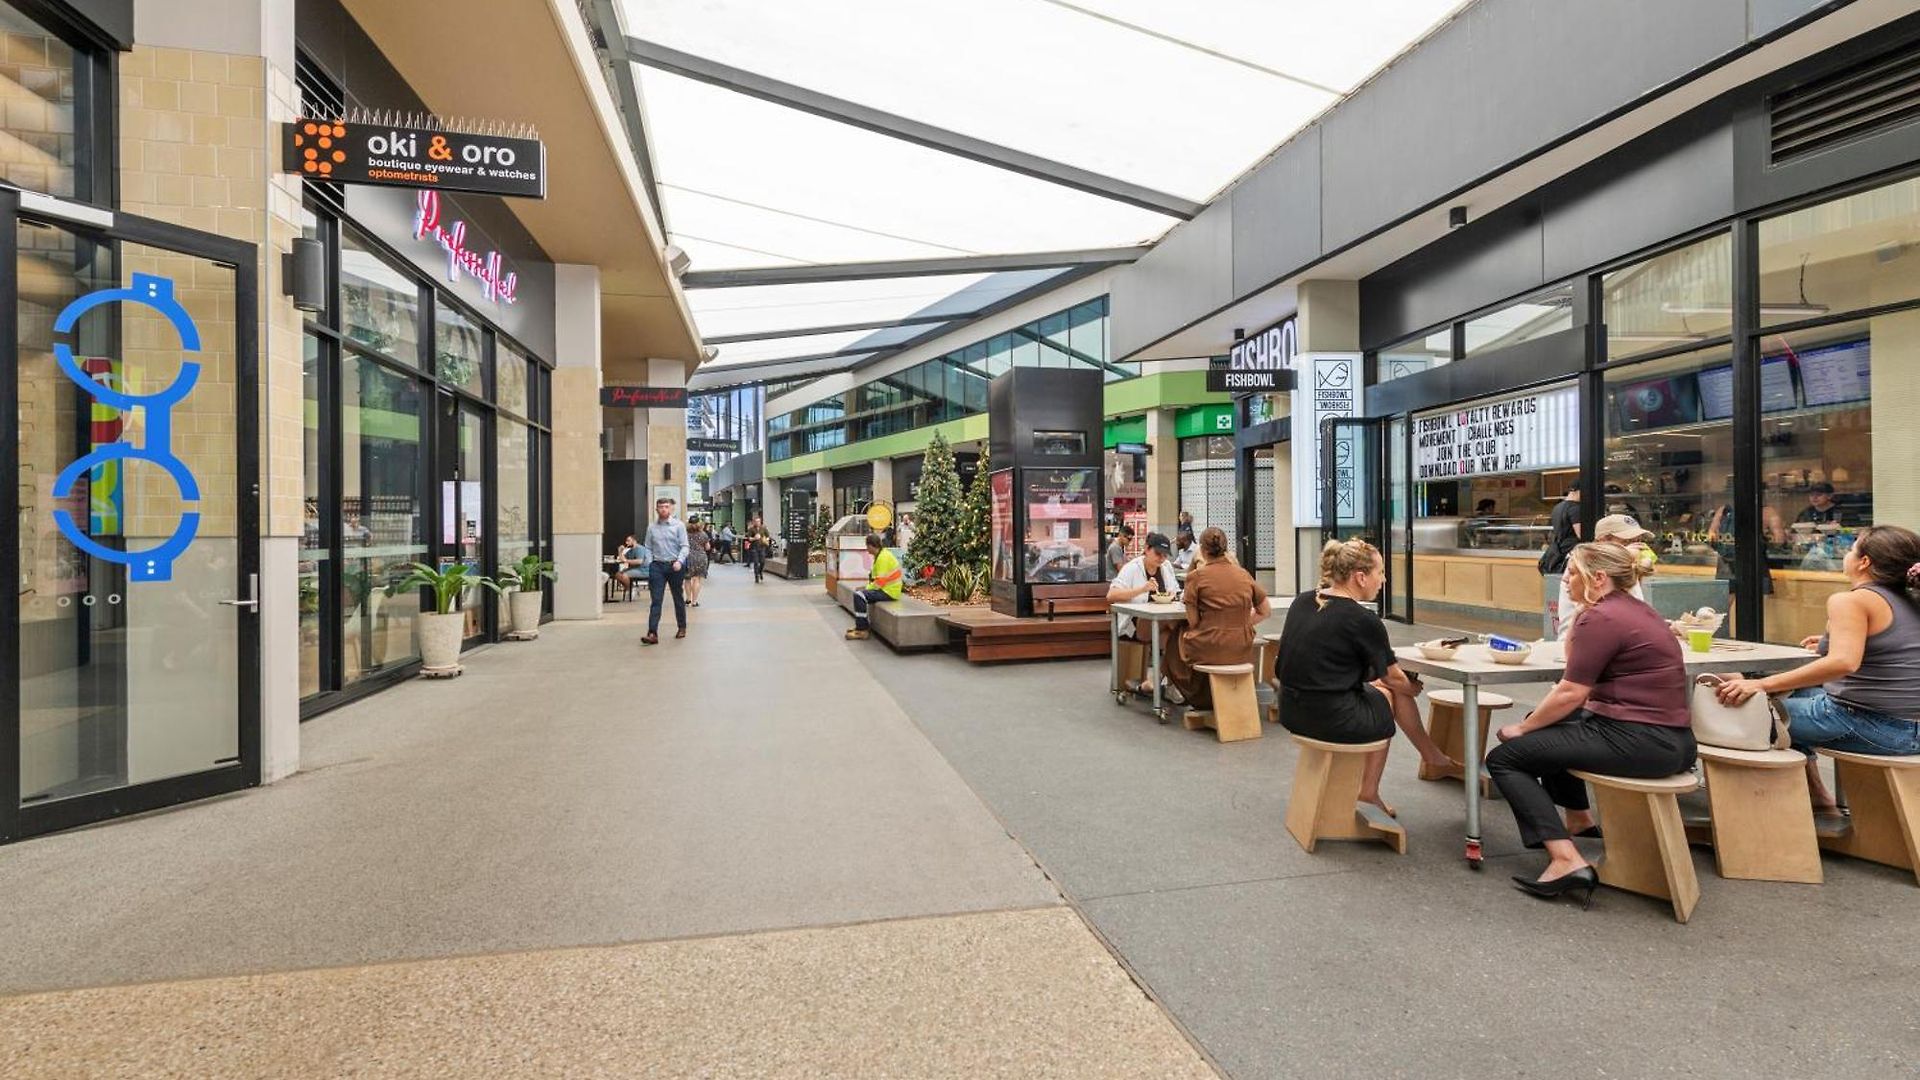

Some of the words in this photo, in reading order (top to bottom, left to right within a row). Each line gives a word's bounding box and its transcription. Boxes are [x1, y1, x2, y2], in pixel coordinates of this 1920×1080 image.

[367, 131, 416, 157] oki
[428, 135, 453, 161] &
[462, 144, 516, 166] oro
[368, 157, 421, 172] boutique
[425, 163, 474, 175] eyewear
[477, 166, 486, 176] &
[489, 169, 536, 181] watches
[368, 169, 439, 183] optometrists
[1231, 320, 1298, 370] FISHBO
[1225, 373, 1275, 387] FISHBOWL
[1317, 391, 1349, 399] FISHBOWL
[1419, 416, 1452, 433] FISHBOWL
[1457, 406, 1490, 427] LOYALTY
[1492, 398, 1537, 420] REWARDS
[1419, 429, 1456, 448] MOVEMENT
[1467, 420, 1514, 441] CHALLENGES
[1436, 447, 1452, 461] JOIN
[1457, 444, 1472, 459] THE
[1475, 440, 1496, 456] CLUB
[1419, 461, 1457, 478] DOWNLOAD
[1459, 459, 1475, 475] OUR
[1481, 456, 1499, 472] NEW
[1504, 453, 1521, 470] APP
